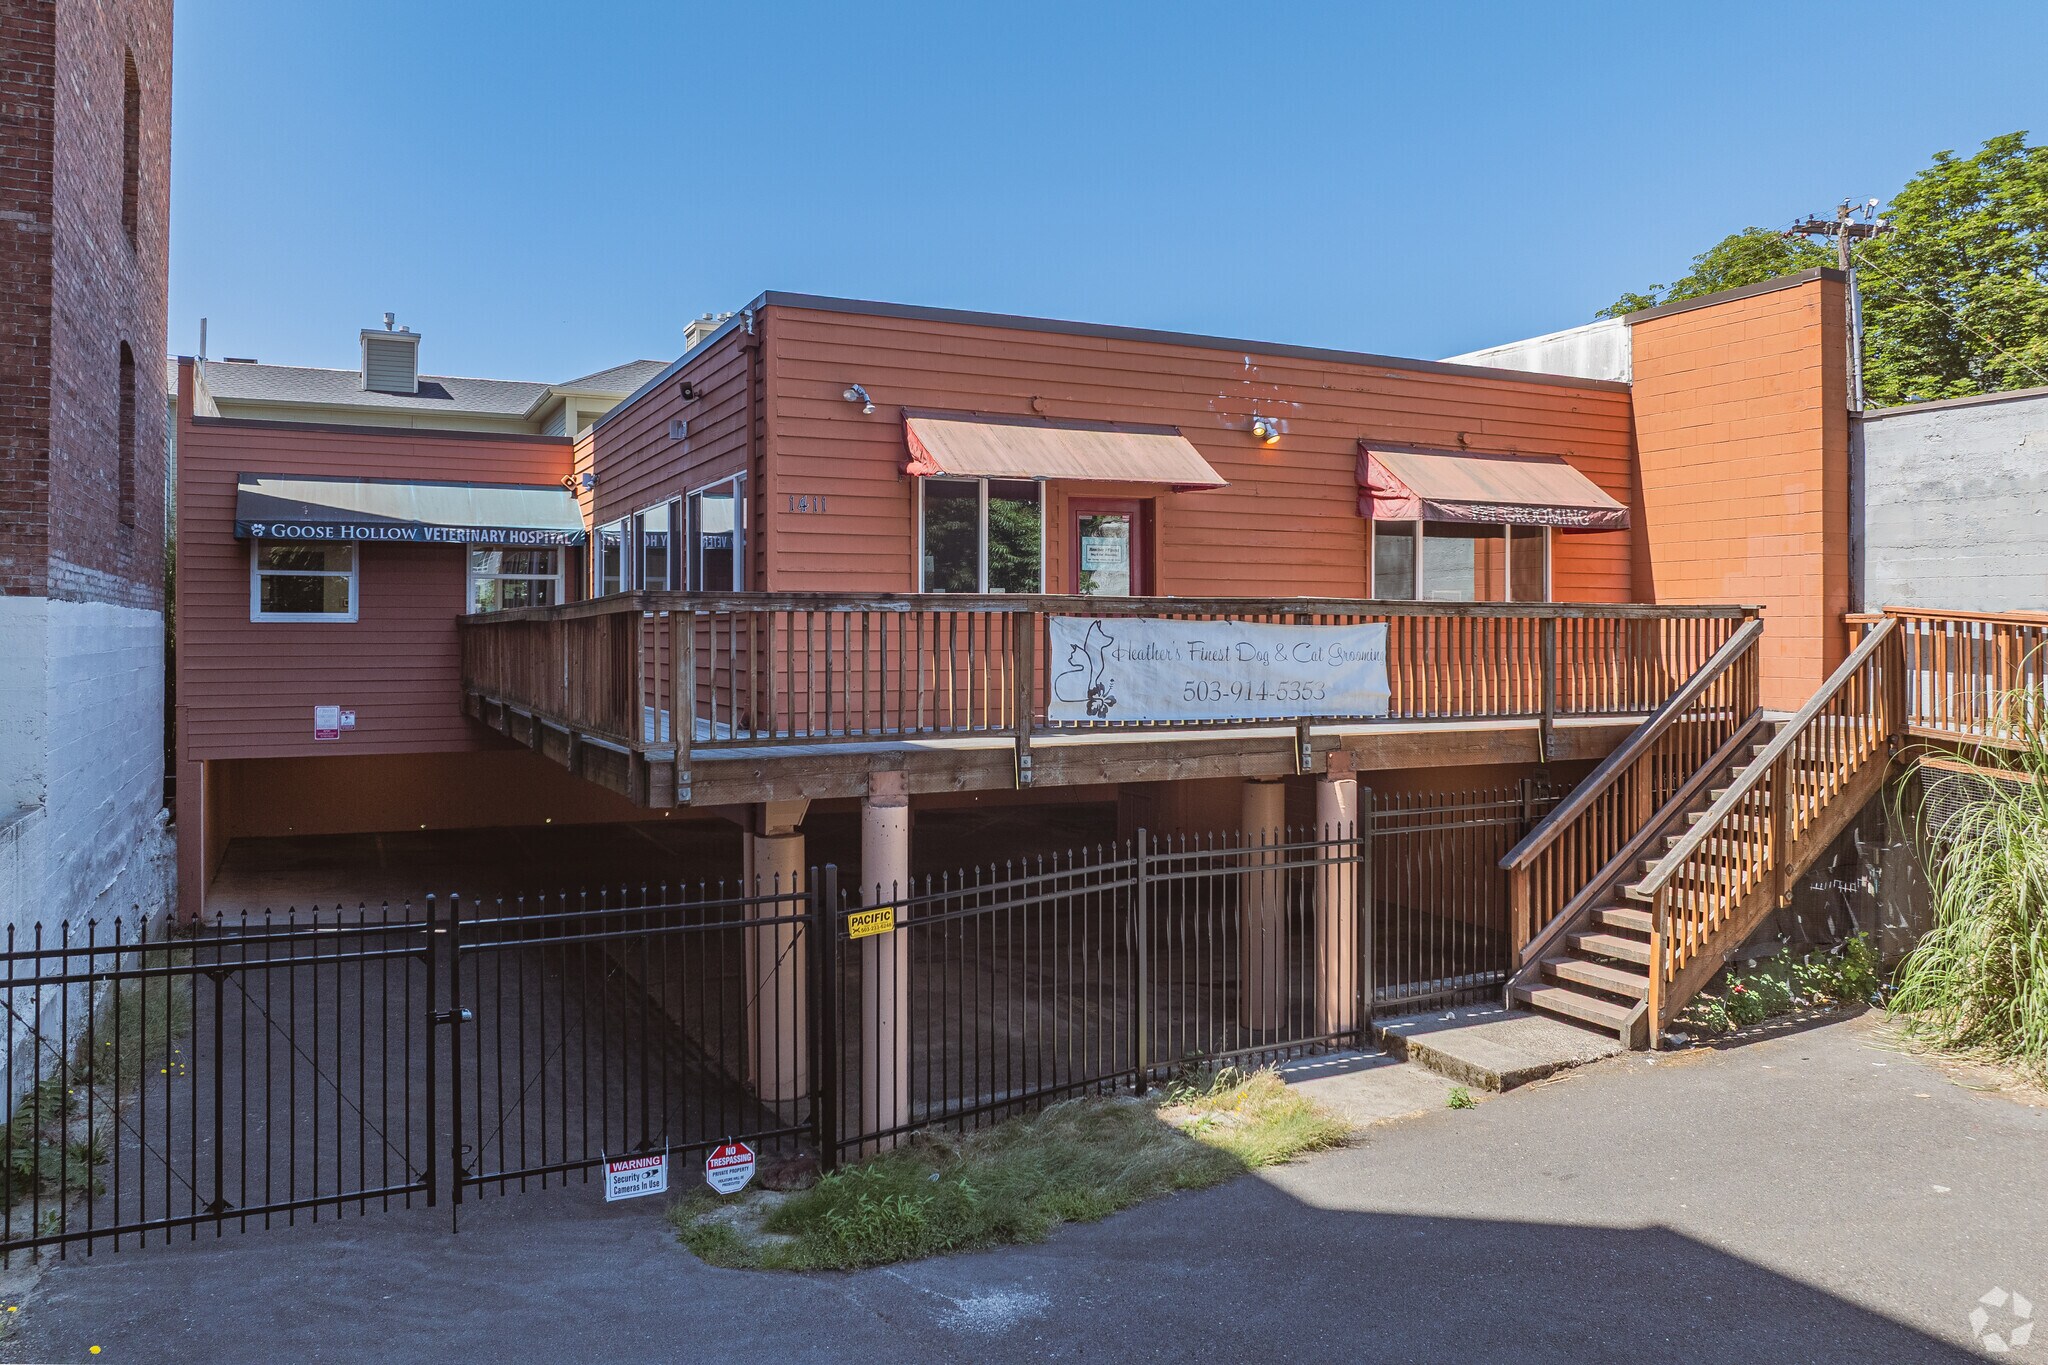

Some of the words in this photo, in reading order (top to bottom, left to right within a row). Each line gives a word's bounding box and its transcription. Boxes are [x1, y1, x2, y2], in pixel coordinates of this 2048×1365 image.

[789, 495, 826, 512] 1411
[1503, 505, 1590, 525] GROOMING
[271, 523, 334, 538] GOOSE
[340, 525, 417, 540] HOLLOW
[424, 527, 505, 542] VETERINARY
[510, 530, 571, 545] HOSPITAL
[1112, 640, 1180, 662] Heather's
[1187, 641, 1230, 662] Finest
[1235, 641, 1270, 666] Dog
[1274, 642, 1288, 662] &
[1292, 642, 1323, 663] Cat
[1328, 642, 1385, 667] Grooming
[1183, 680, 1326, 703] 503-914-5353
[852, 911, 891, 927] PACIFIC
[726, 1146, 736, 1156] NO
[612, 1156, 660, 1172] WARNING
[710, 1153, 752, 1167] TRESPASSING
[614, 1172, 640, 1184] Security
[729, 1166, 749, 1174] PROPERTY
[614, 1184, 640, 1194] Cameras
[642, 1182, 648, 1190] In
[649, 1180, 660, 1188] Use
